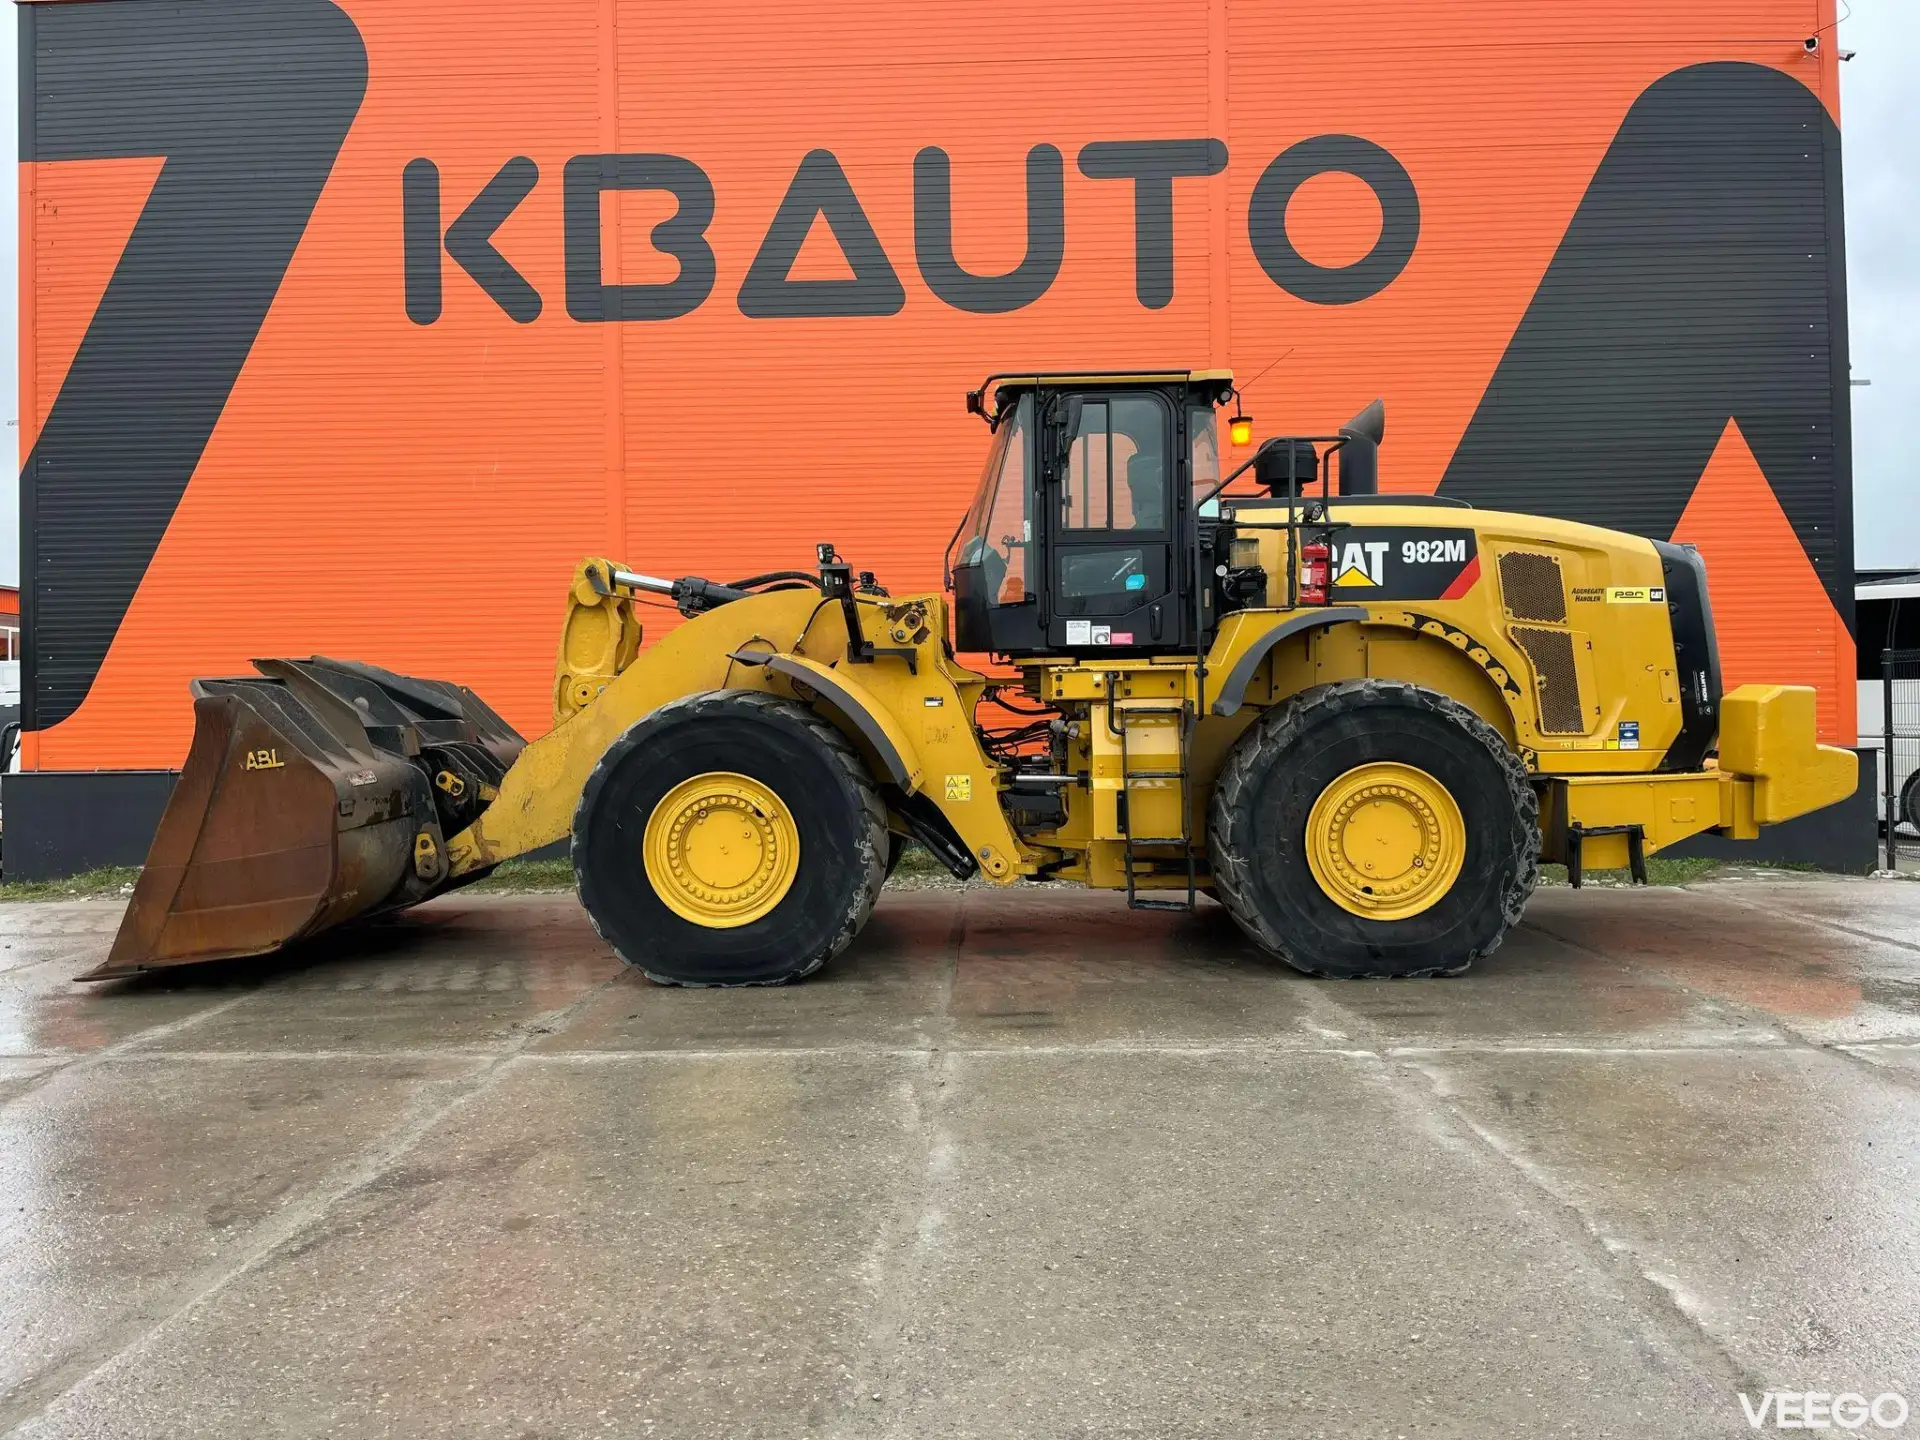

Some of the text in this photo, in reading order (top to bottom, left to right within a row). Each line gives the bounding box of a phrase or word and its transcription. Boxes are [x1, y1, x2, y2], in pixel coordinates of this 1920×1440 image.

[403, 134, 1420, 324] KBAUTO
[1402, 540, 1466, 564] 982M
[246, 749, 285, 771] ABL
